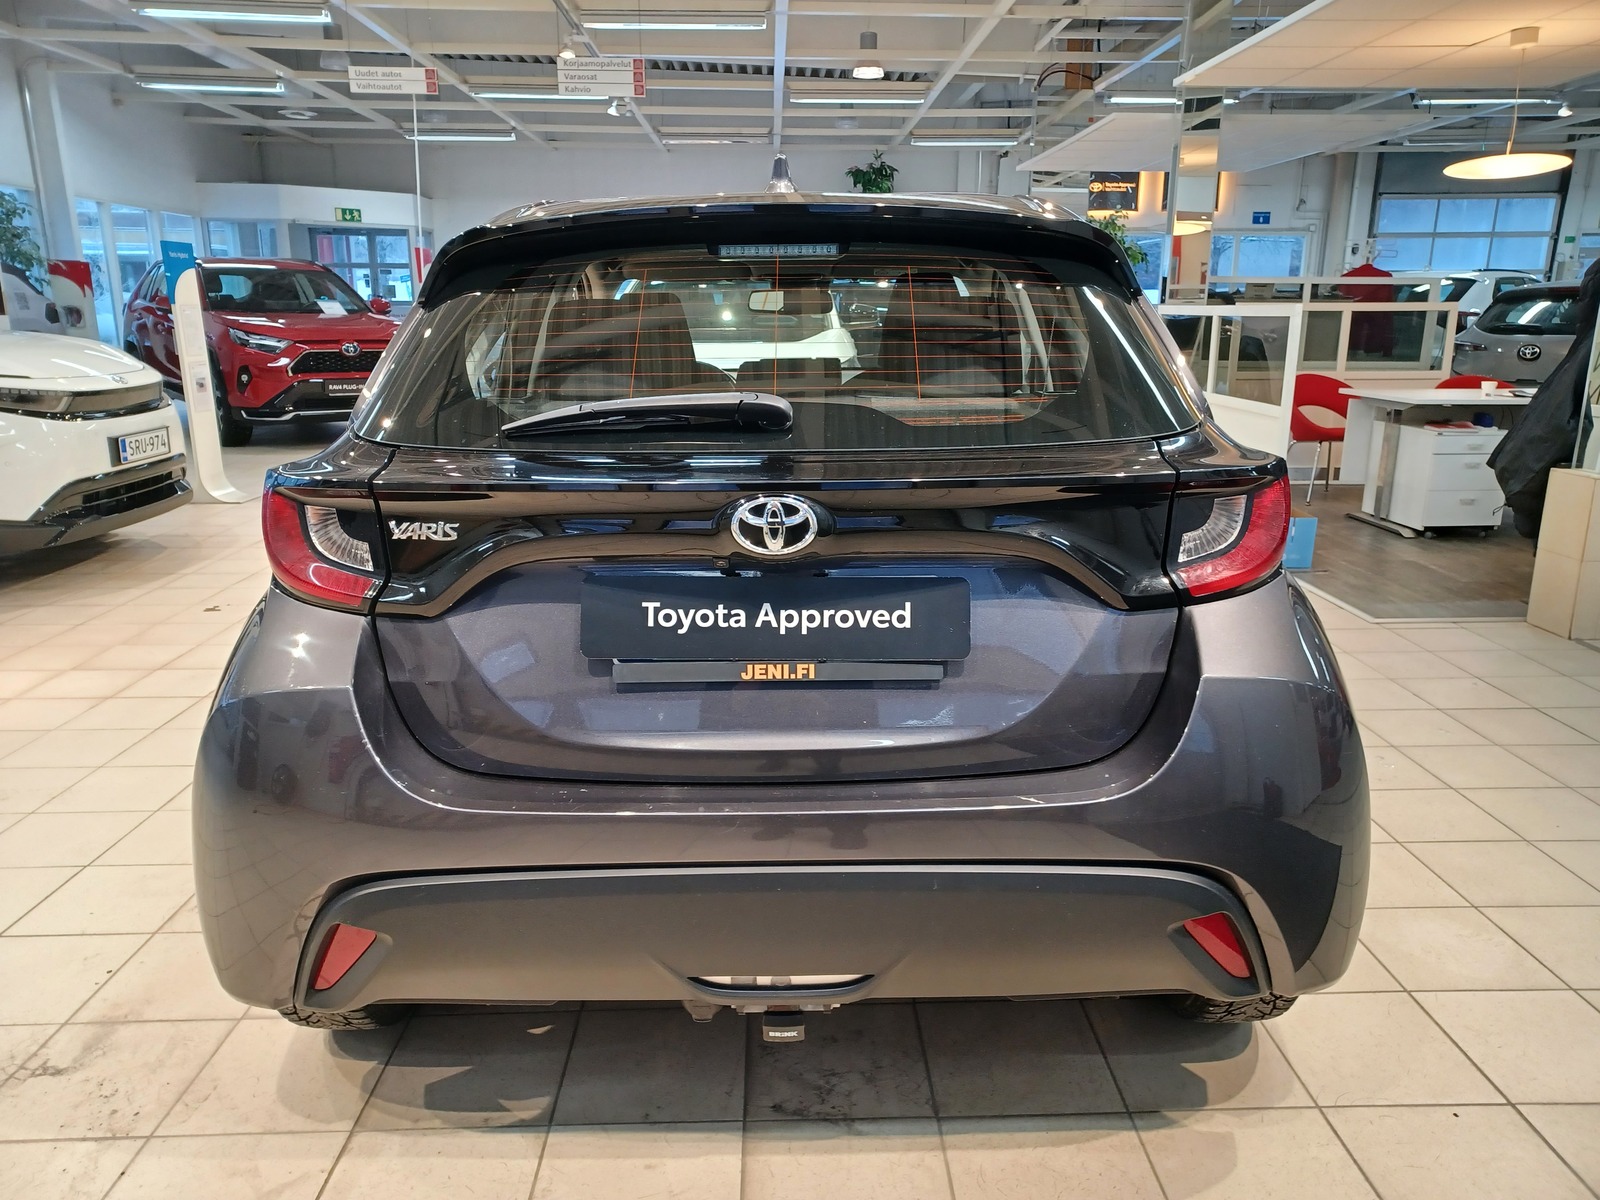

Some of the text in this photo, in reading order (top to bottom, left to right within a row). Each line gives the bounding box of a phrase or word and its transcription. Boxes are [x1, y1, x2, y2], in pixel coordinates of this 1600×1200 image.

[563, 60, 631, 69] Korjaamopalvelut
[354, 69, 379, 78] Uudet
[564, 73, 598, 81] Varaosat
[356, 82, 402, 91] Vaihtoautot
[128, 434, 167, 456] SRU-974
[642, 601, 911, 635] Toyota Approved
[740, 663, 815, 680] JENI.FI
